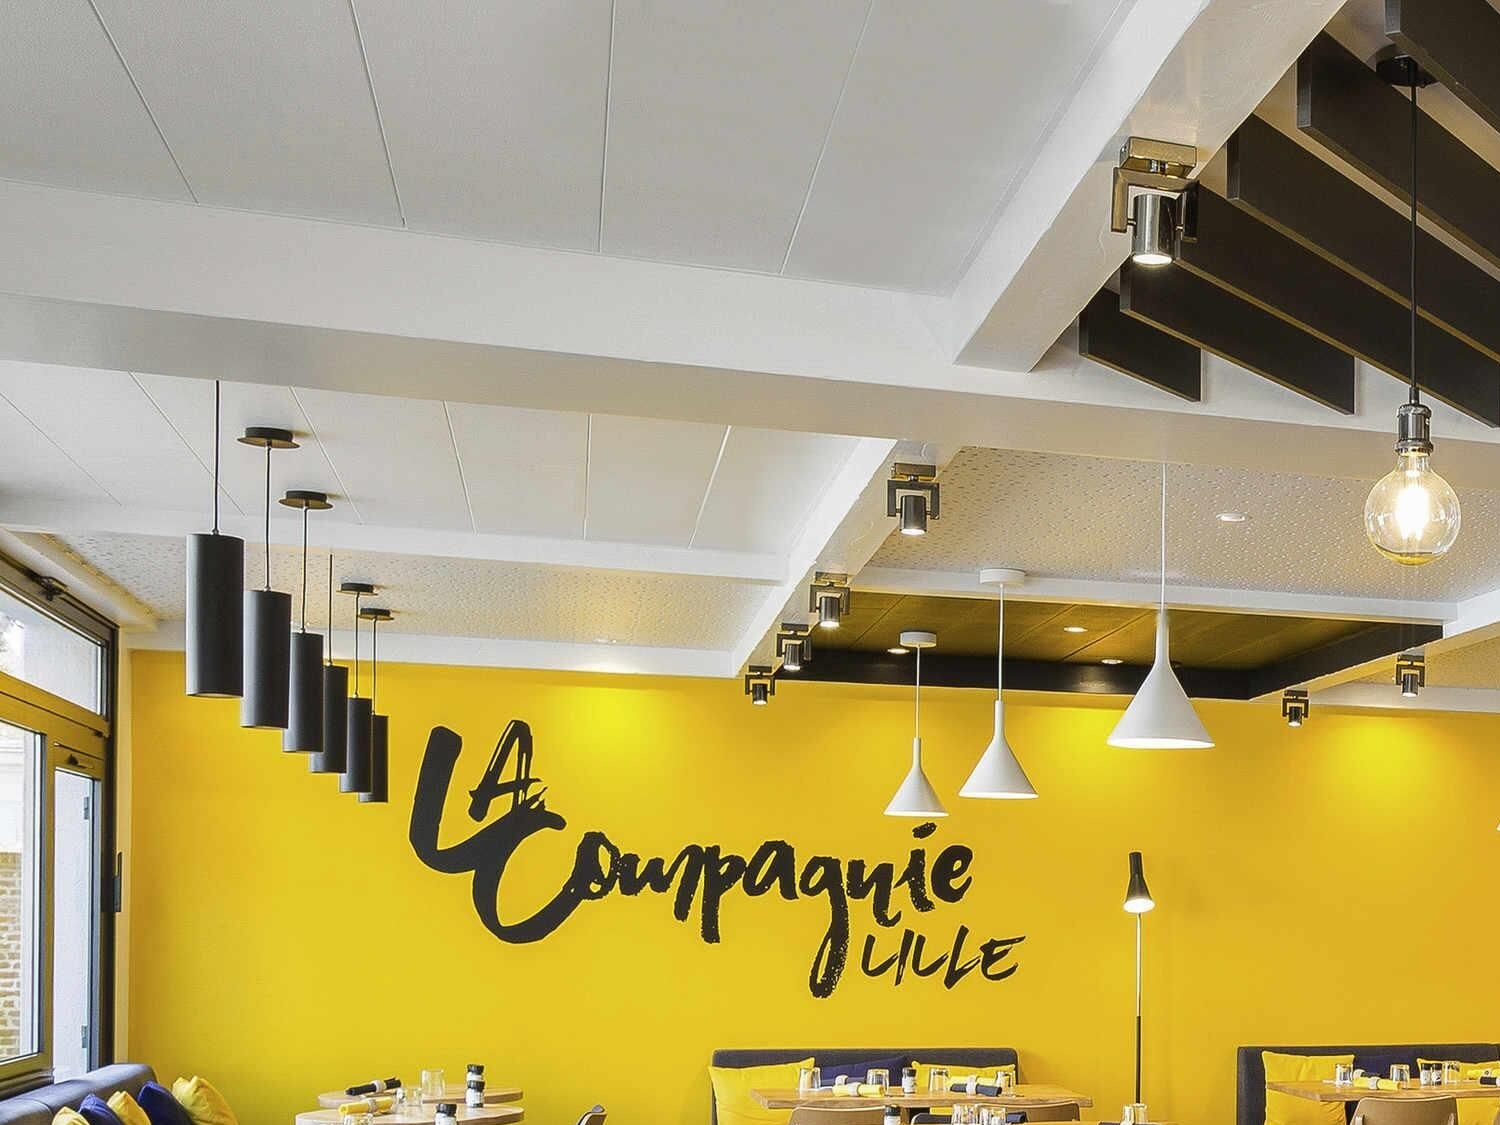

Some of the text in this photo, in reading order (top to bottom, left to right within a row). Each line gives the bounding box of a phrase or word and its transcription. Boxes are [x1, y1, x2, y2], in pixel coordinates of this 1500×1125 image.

[409, 719, 545, 874] LA
[472, 808, 974, 999] Compagnie
[860, 925, 1027, 990] LILLE
